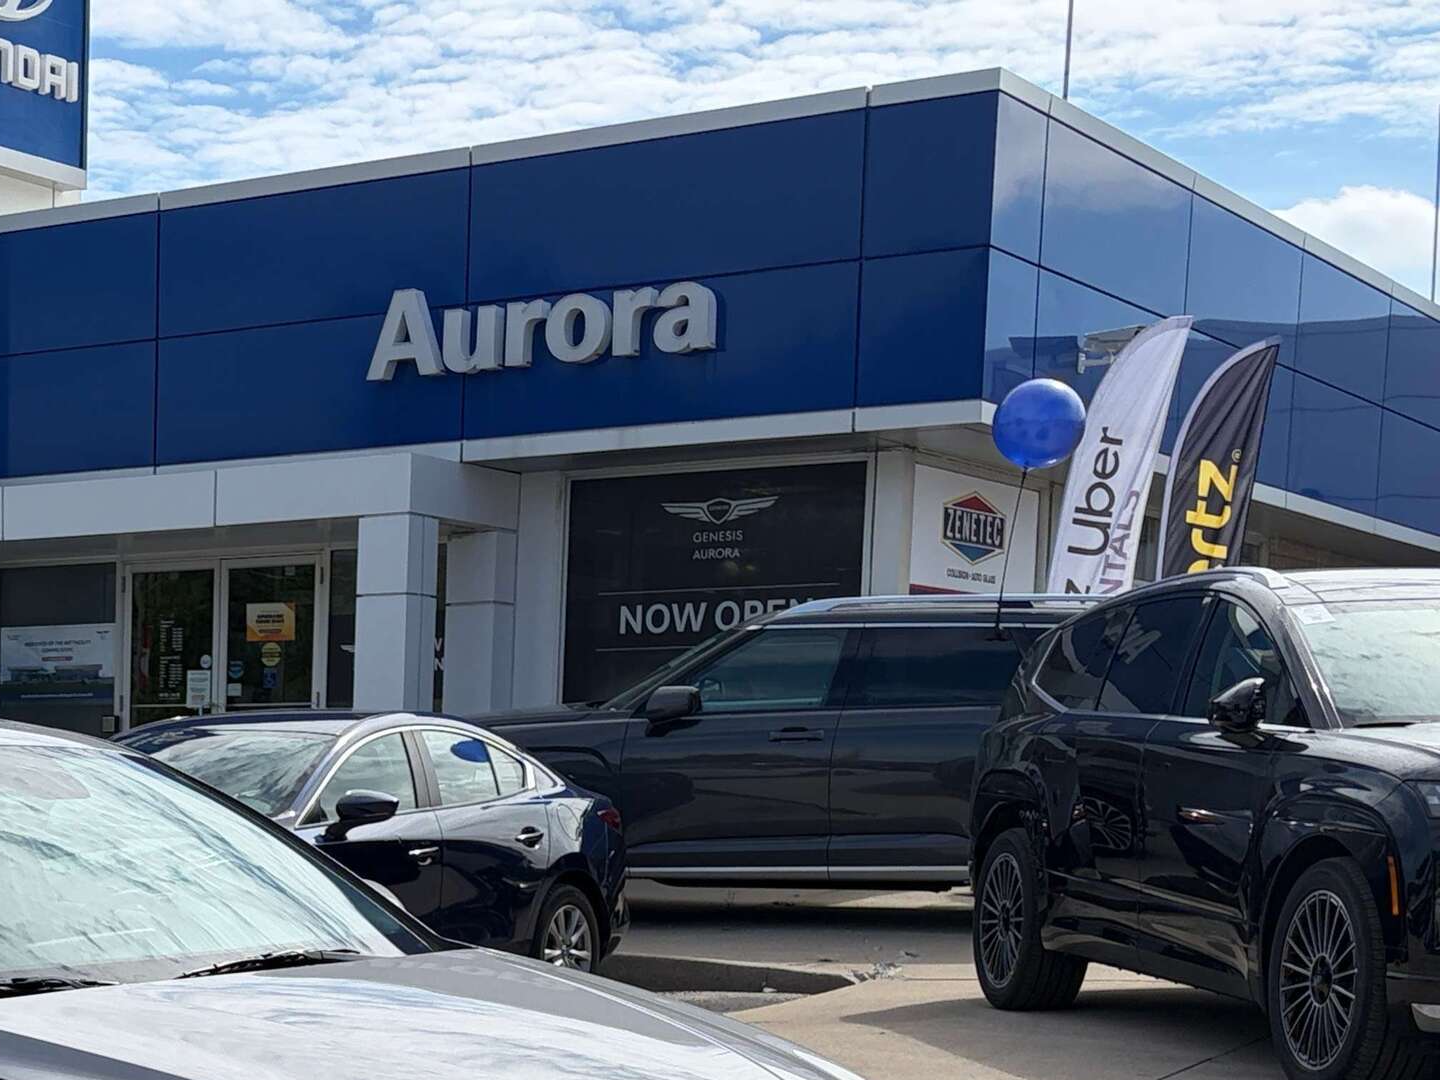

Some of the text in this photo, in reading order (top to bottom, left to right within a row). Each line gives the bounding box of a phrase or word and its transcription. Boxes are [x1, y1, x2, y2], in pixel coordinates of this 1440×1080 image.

[366, 281, 718, 381] Aurora
[1067, 427, 1123, 556] Uber
[692, 530, 744, 543] GENESIS
[946, 509, 1002, 546] ZENETEC
[1097, 490, 1141, 594] NTALS
[692, 547, 741, 560] AURORA
[619, 602, 708, 635] NOW
